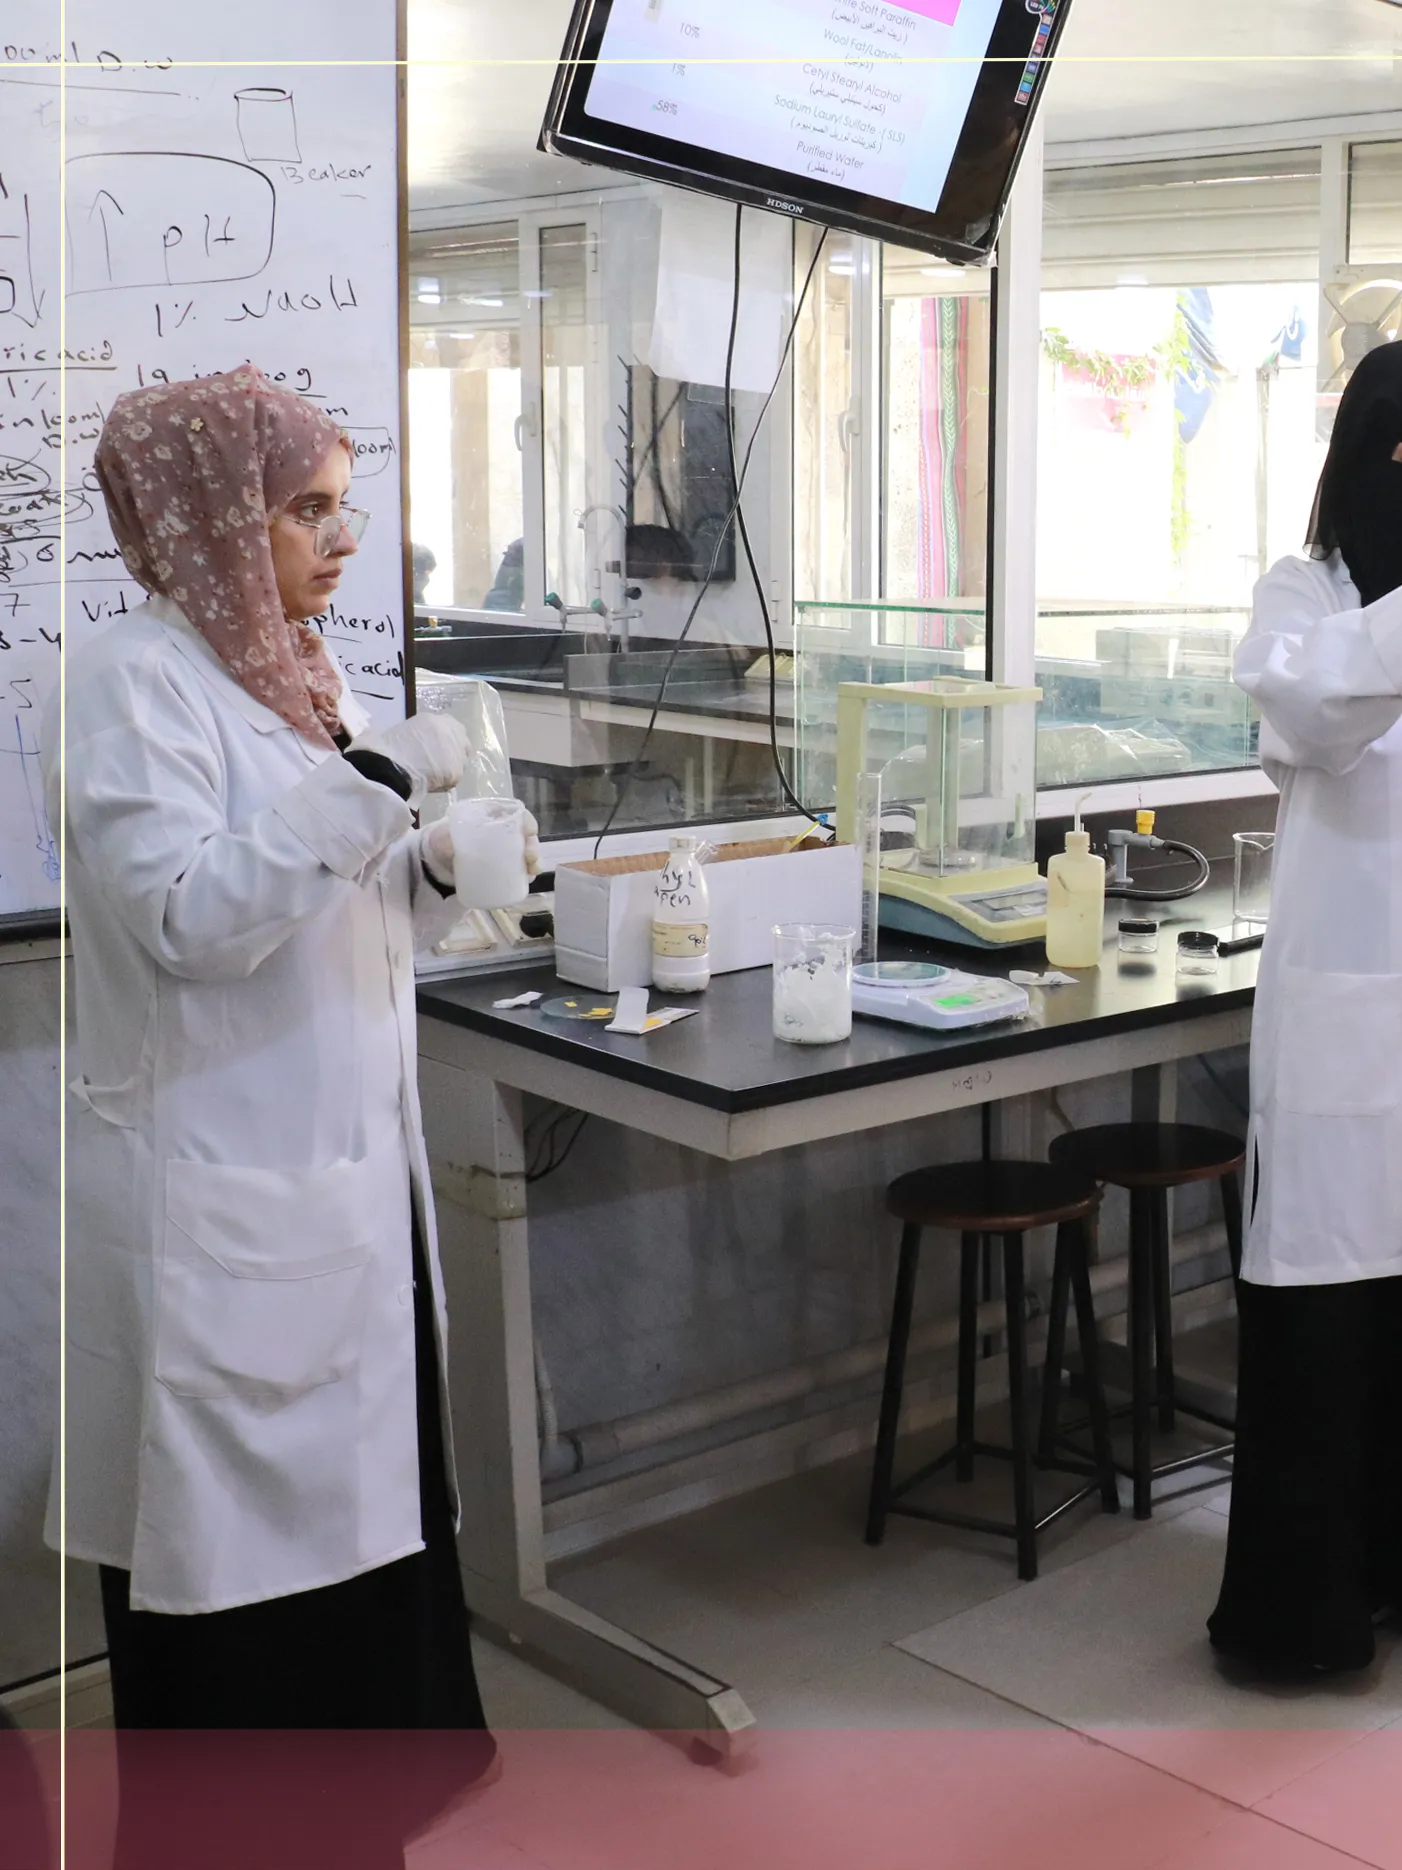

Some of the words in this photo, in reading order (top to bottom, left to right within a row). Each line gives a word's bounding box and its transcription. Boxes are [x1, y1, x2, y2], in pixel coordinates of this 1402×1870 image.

[680, 22, 700, 38] 10%
[860, 1, 878, 16] Soft
[880, 8, 917, 30] Paraffin
[824, 29, 849, 46] Wool
[802, 62, 829, 80] Cetyl
[831, 70, 864, 93] Stearyl
[865, 84, 902, 103] Alcohol
[774, 95, 811, 115] Sodium
[813, 104, 842, 125] Lauryl
[843, 114, 876, 135] Sulfate
[796, 141, 833, 161] Purified
[835, 152, 864, 170] Water
